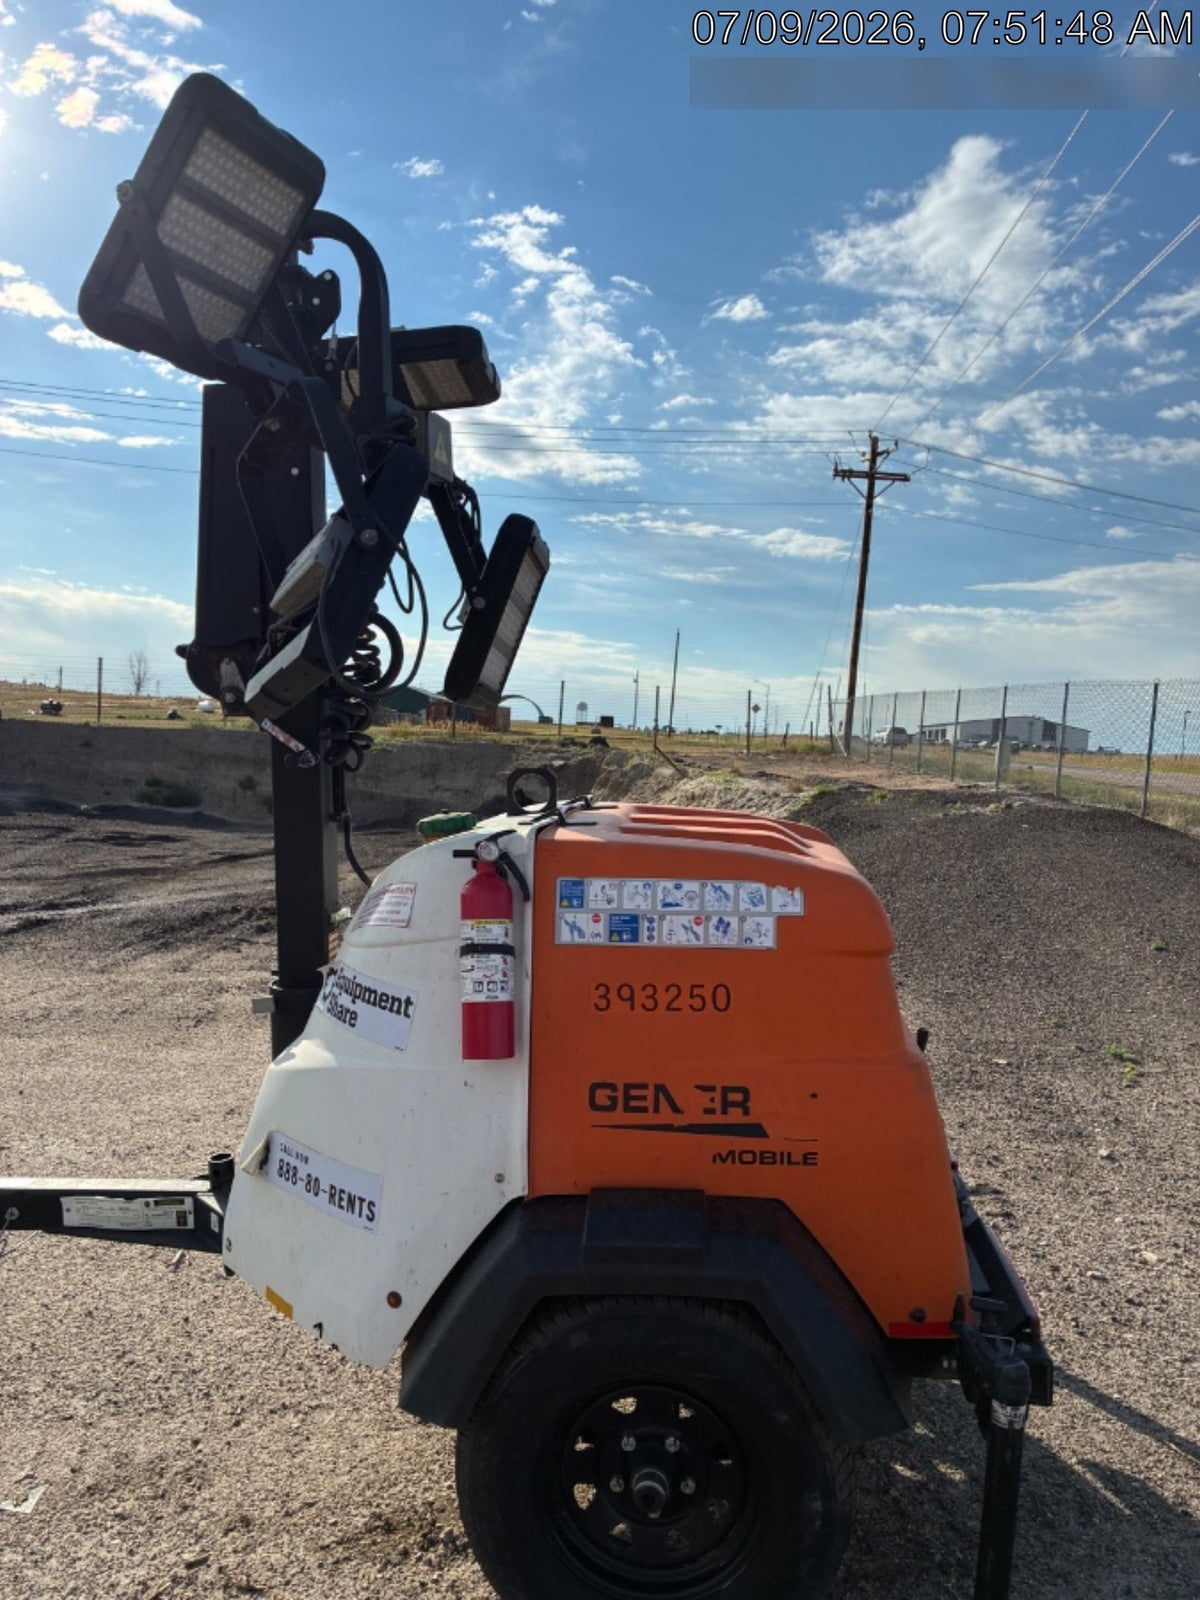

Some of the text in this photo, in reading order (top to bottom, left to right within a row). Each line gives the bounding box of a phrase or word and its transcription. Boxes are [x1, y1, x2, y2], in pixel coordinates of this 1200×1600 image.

[593, 982, 732, 1013] 393250
[712, 1149, 818, 1166] MOBILE
[277, 1158, 376, 1223] 888-80-RENTS
